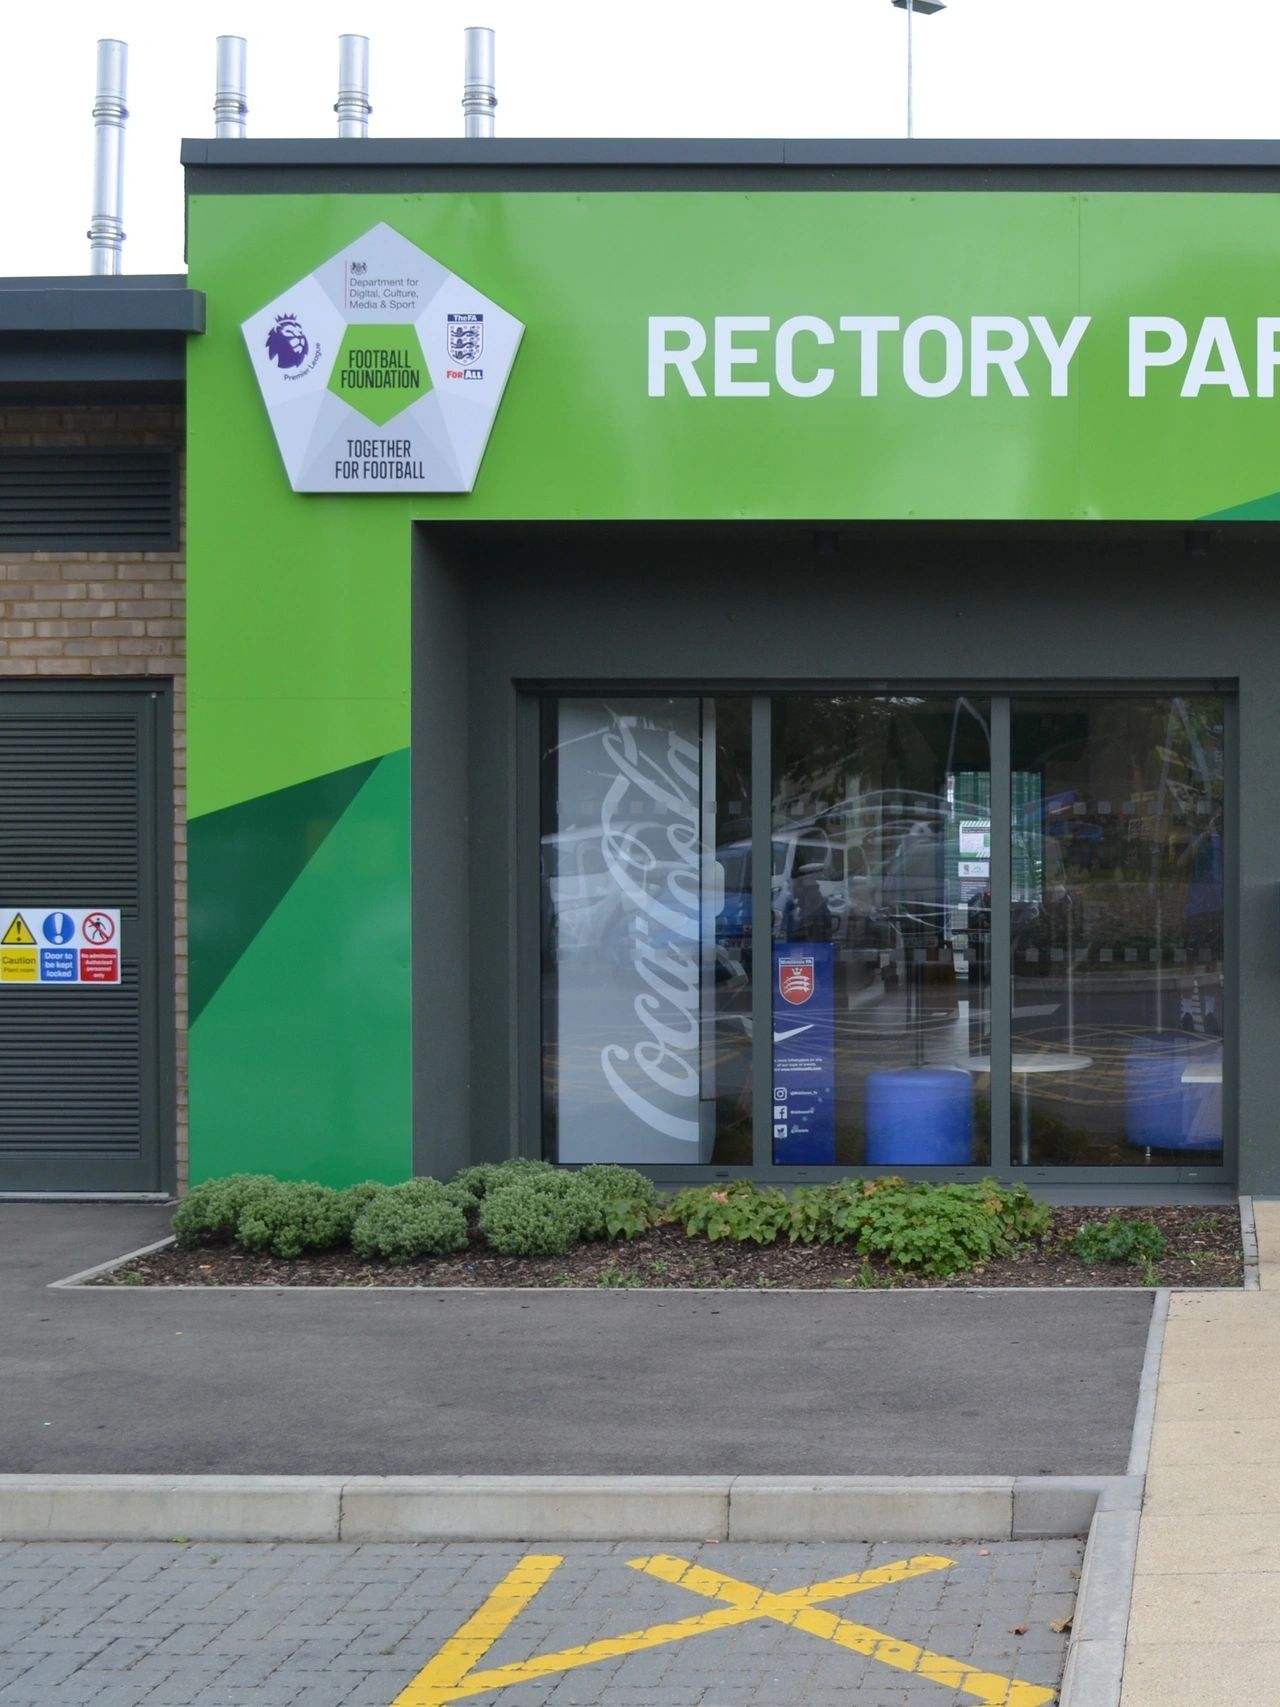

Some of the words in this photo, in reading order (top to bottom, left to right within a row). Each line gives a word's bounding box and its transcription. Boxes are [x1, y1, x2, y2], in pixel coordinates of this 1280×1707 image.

[350, 278, 404, 288] Department
[406, 277, 419, 286] for
[350, 289, 381, 299] Digital,
[383, 289, 419, 300] Culture,
[349, 300, 378, 309] Media
[380, 300, 387, 309] &
[389, 300, 415, 310] Sport
[307, 342, 322, 369] League
[349, 350, 411, 368] FOOTBALL
[647, 314, 1092, 398] RECTORY
[284, 368, 309, 381] Premier
[341, 370, 420, 389] FOUNDATION
[347, 440, 411, 458] TOGETHER
[335, 461, 359, 479] FOR
[363, 461, 425, 479] FOOTBALL
[2, 956, 37, 965] Caution
[45, 952, 63, 960] Door
[65, 952, 73, 960] to
[45, 961, 56, 969] be
[56, 961, 73, 970] kept
[46, 970, 72, 978] locked
